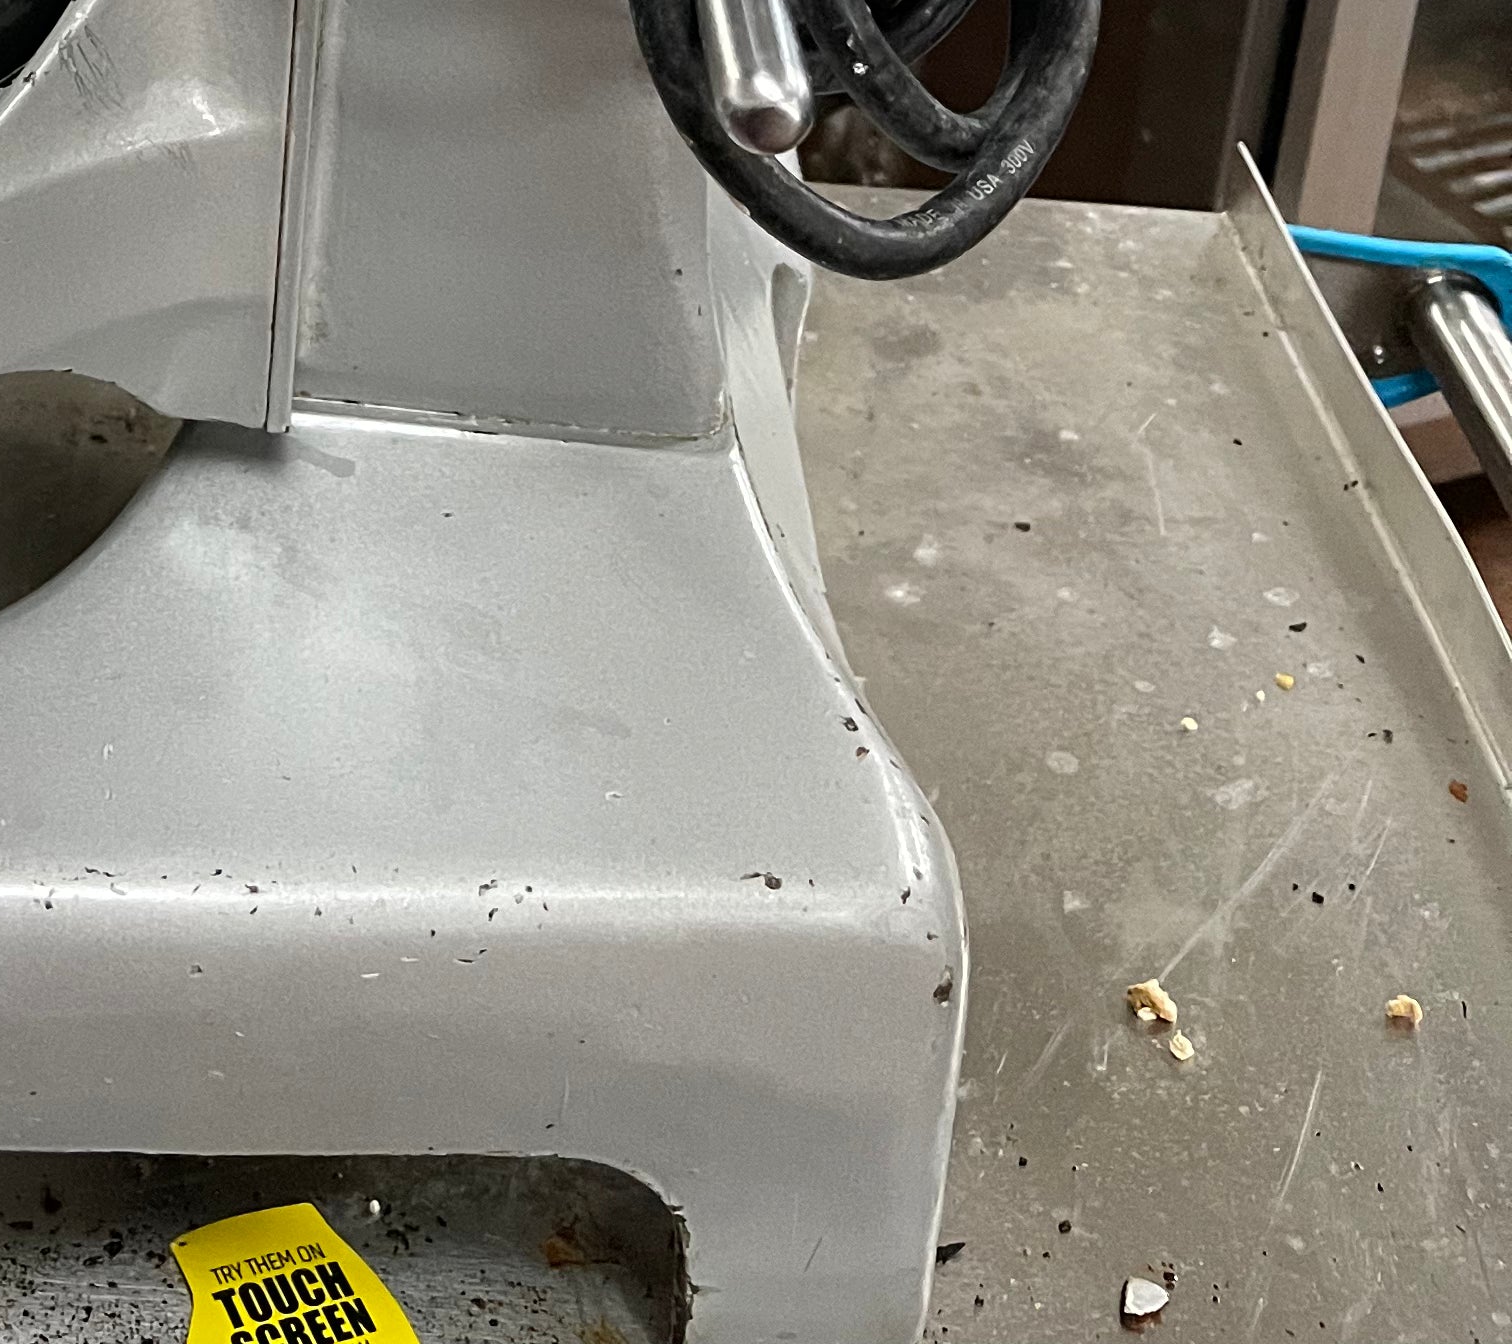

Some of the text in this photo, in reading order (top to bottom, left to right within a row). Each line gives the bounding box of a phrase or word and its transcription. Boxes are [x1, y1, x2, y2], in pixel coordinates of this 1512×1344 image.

[966, 173, 1004, 201] USA
[1001, 138, 1036, 174] 300V
[209, 1242, 326, 1285] TRY THEM ON
[211, 1261, 355, 1329] TOUCH
